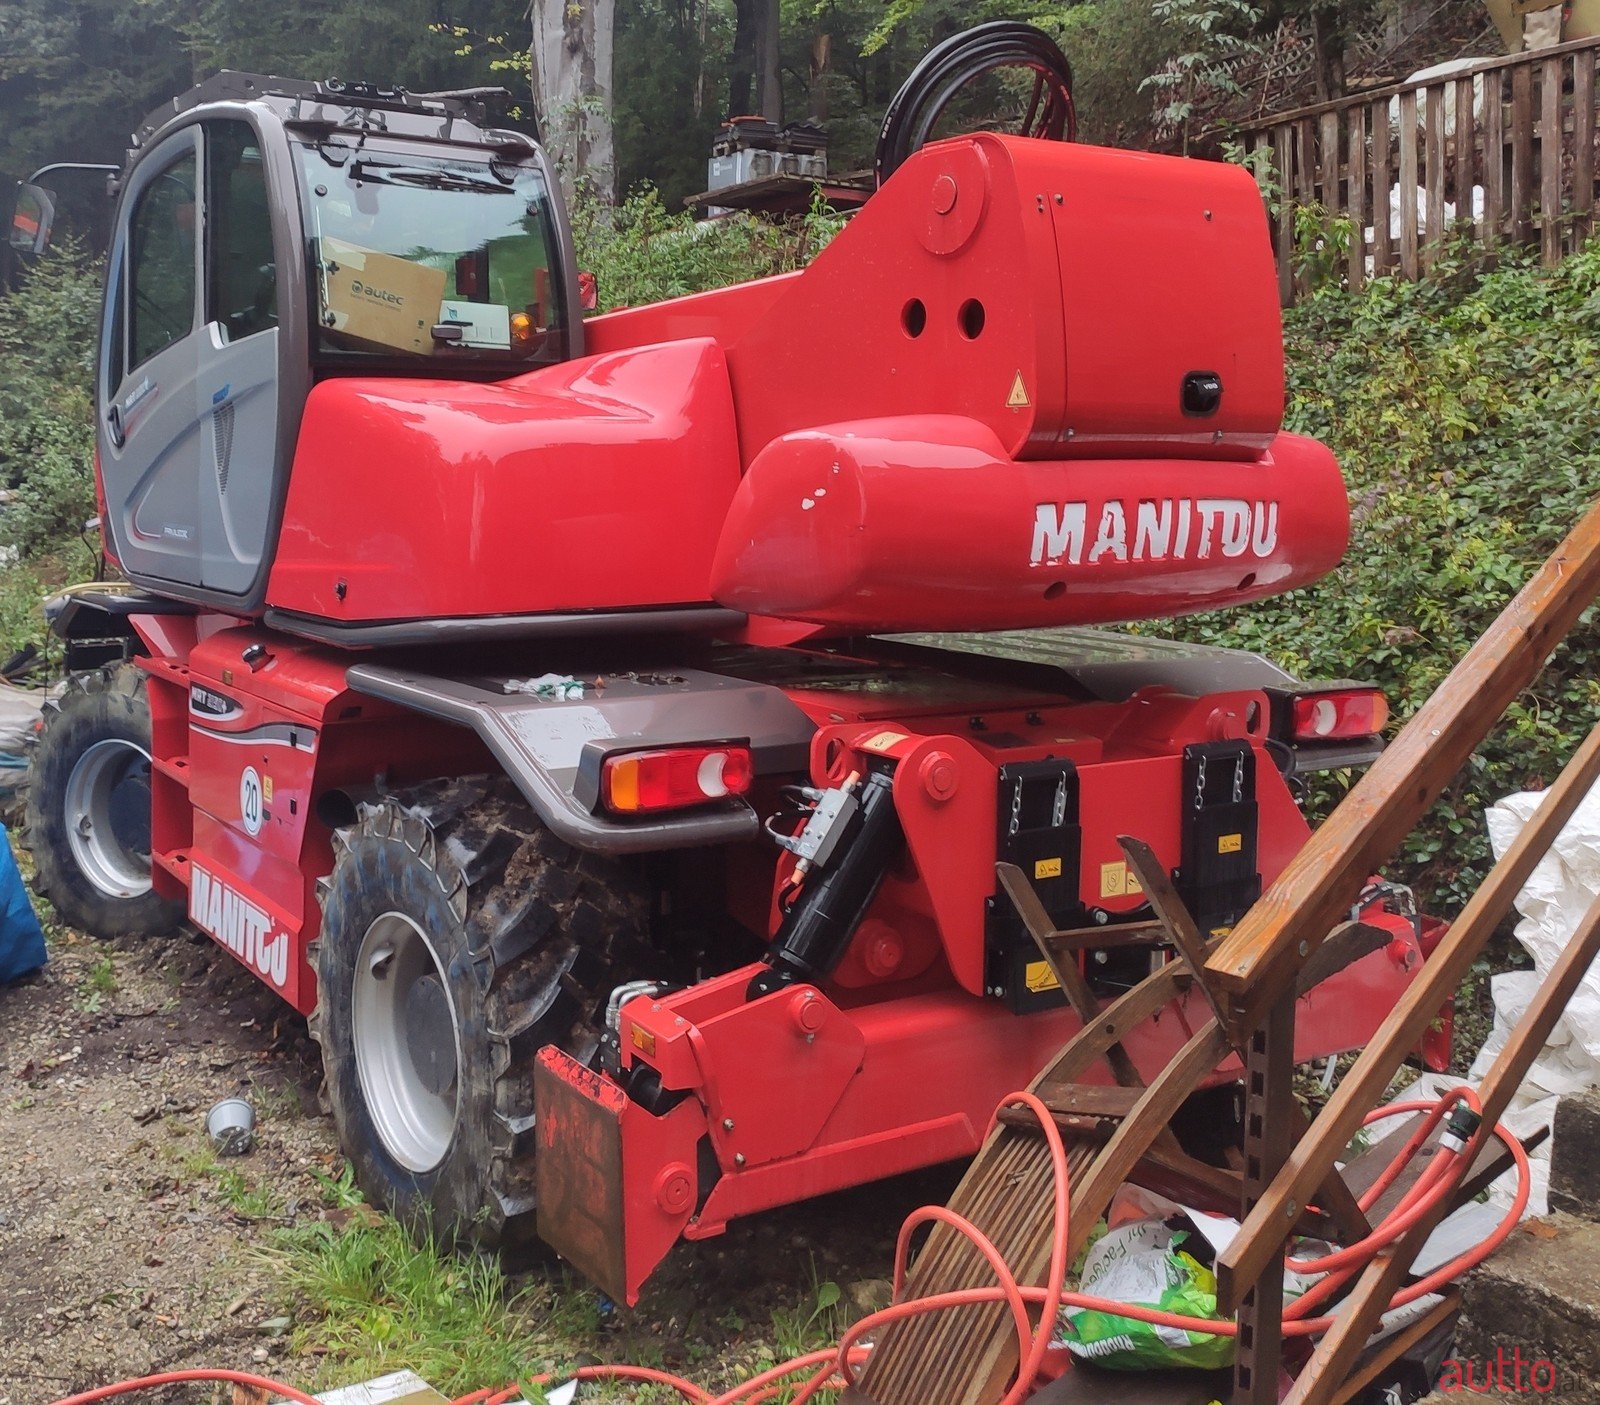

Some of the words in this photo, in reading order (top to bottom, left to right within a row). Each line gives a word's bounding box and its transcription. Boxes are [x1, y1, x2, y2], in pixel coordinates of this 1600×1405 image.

[364, 285, 405, 306] autec
[1029, 498, 1278, 567] MANITOU
[245, 780, 258, 822] 20
[191, 861, 289, 988] MANITOU
